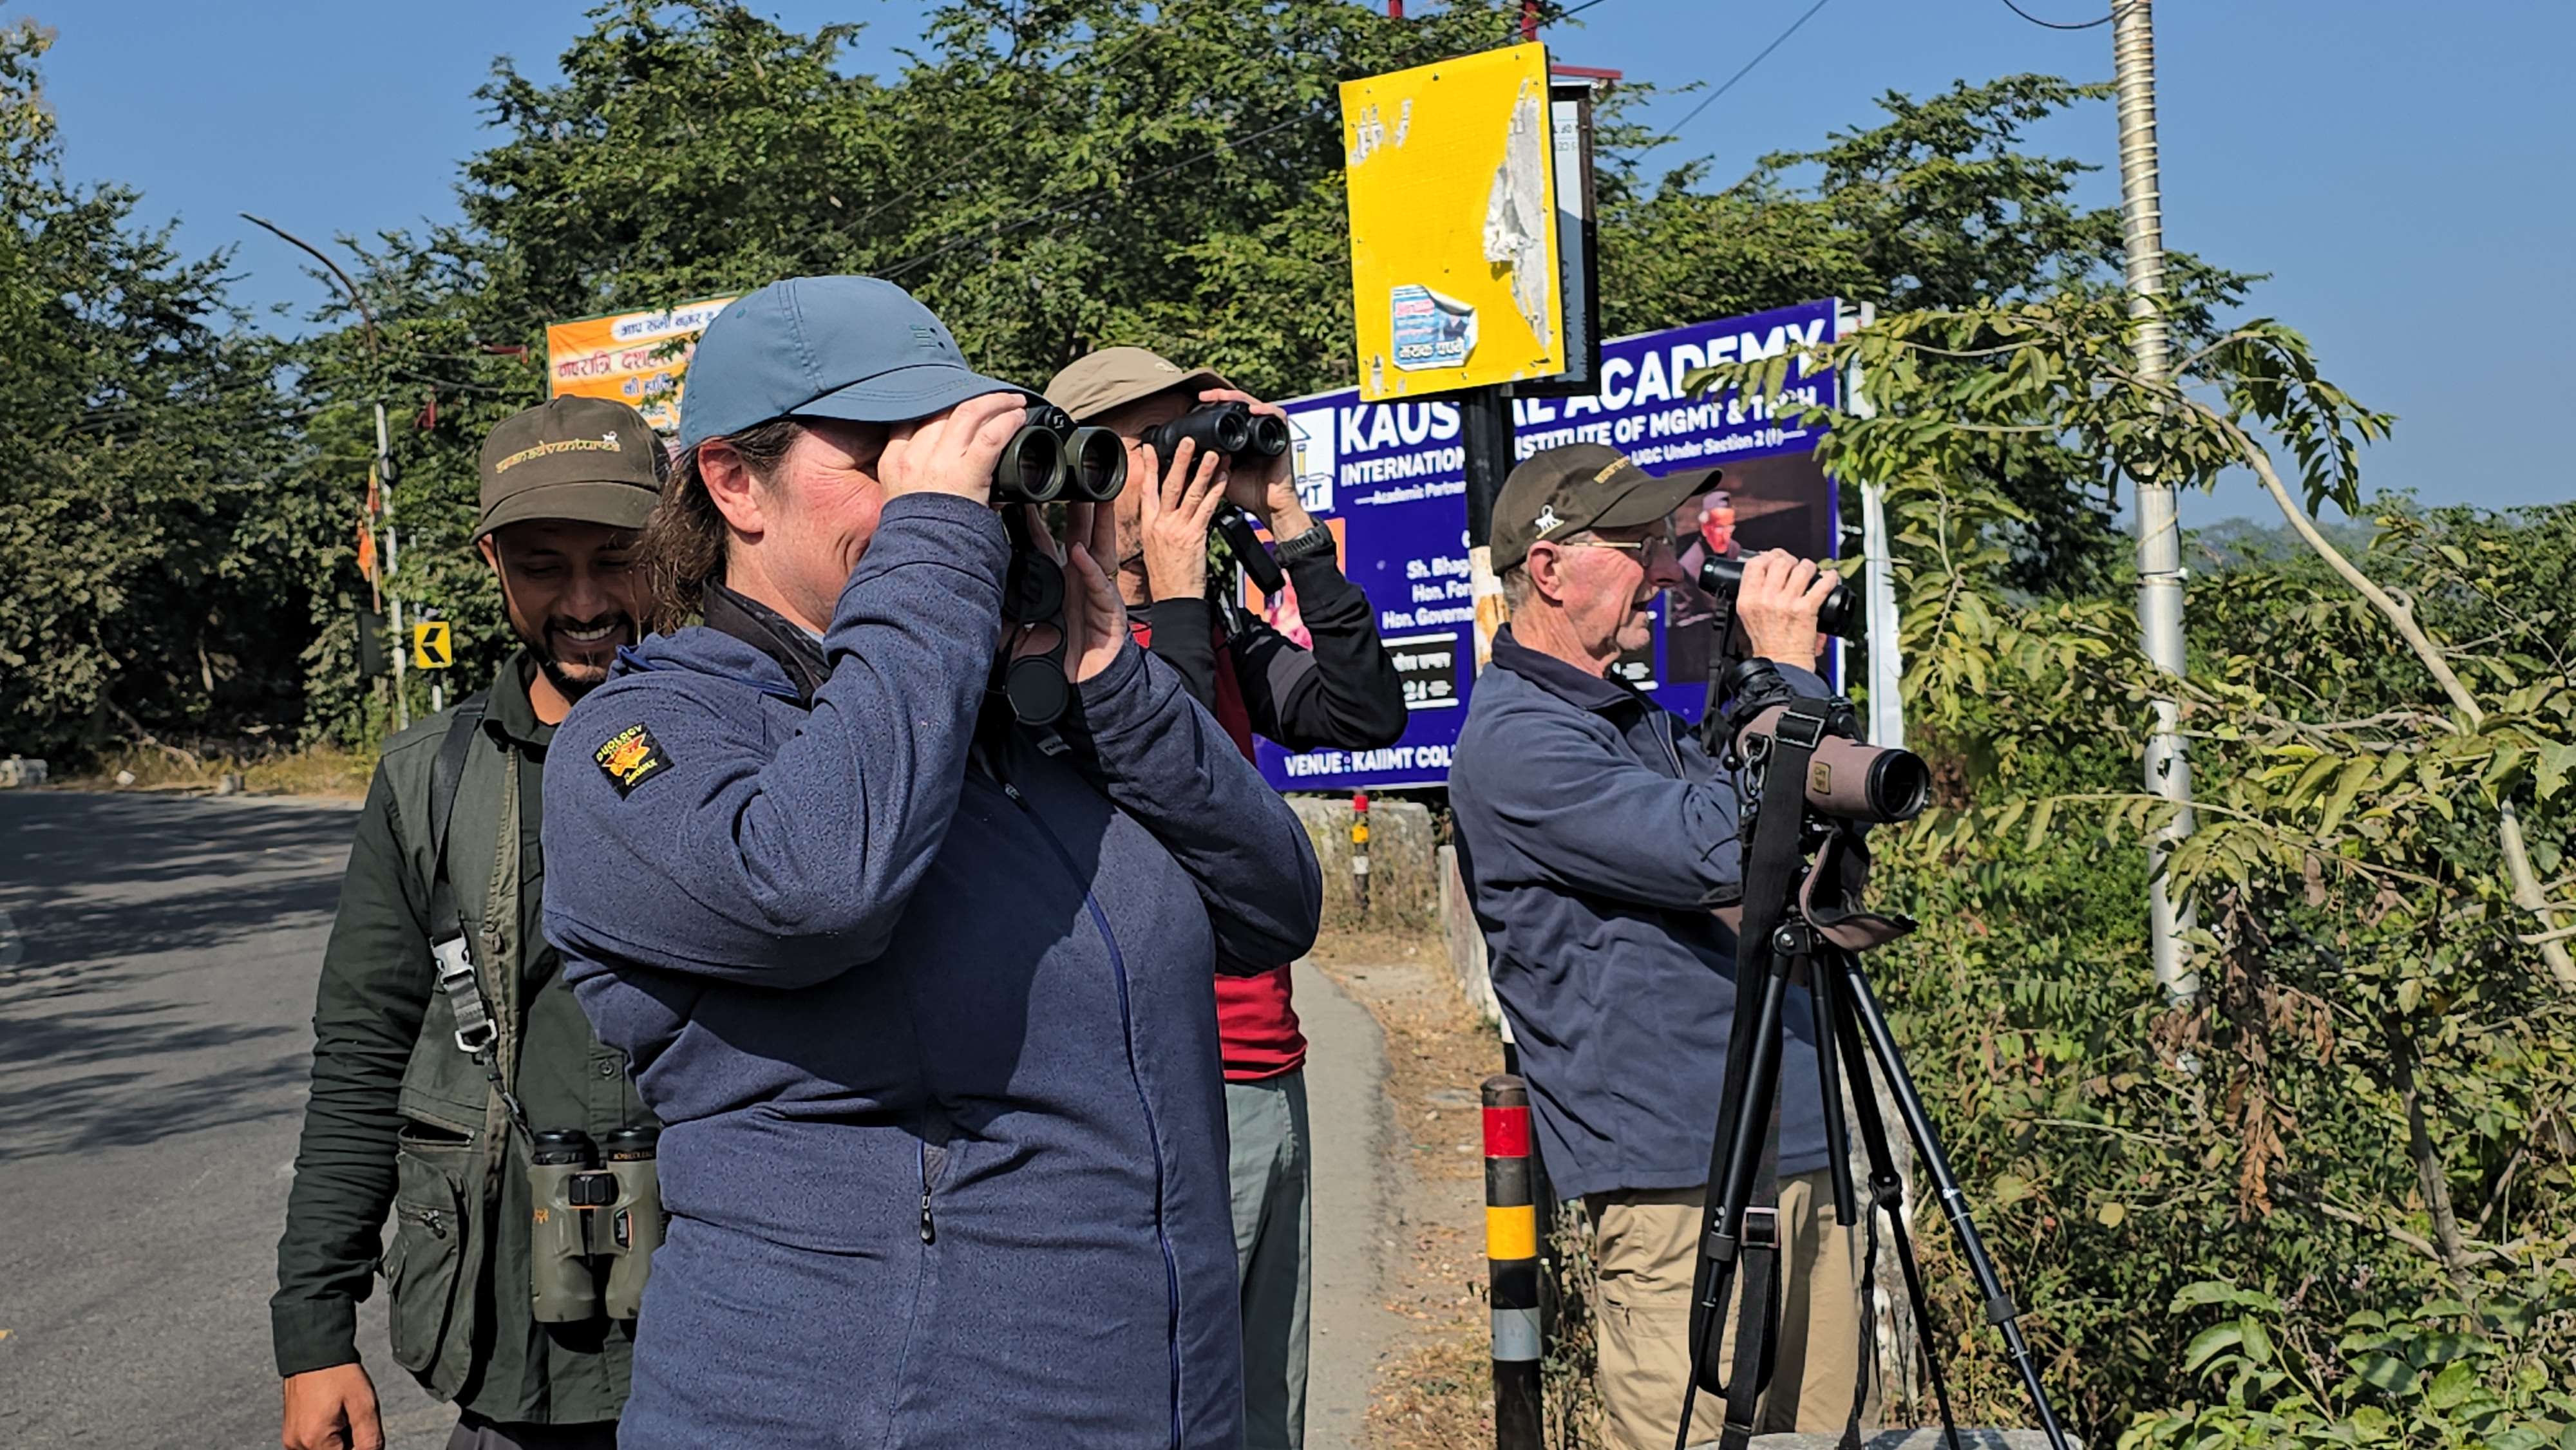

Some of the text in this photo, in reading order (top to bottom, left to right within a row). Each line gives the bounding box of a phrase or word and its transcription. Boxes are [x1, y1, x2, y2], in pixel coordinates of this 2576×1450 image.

[1340, 446, 1466, 487] INTERNATION
[1615, 415, 1647, 444] OF
[1649, 403, 1723, 438] MGMT
[1726, 398, 1746, 426] &
[1631, 446, 1663, 466] UGC
[1663, 440, 1703, 462] Under
[1703, 433, 1754, 455] Section
[1754, 429, 1765, 447] 2
[1406, 555, 1470, 579] Sh. Bhag
[1412, 583, 1445, 603] Hon.
[1381, 607, 1475, 630] Hon. Governo
[1415, 744, 1455, 768] COL
